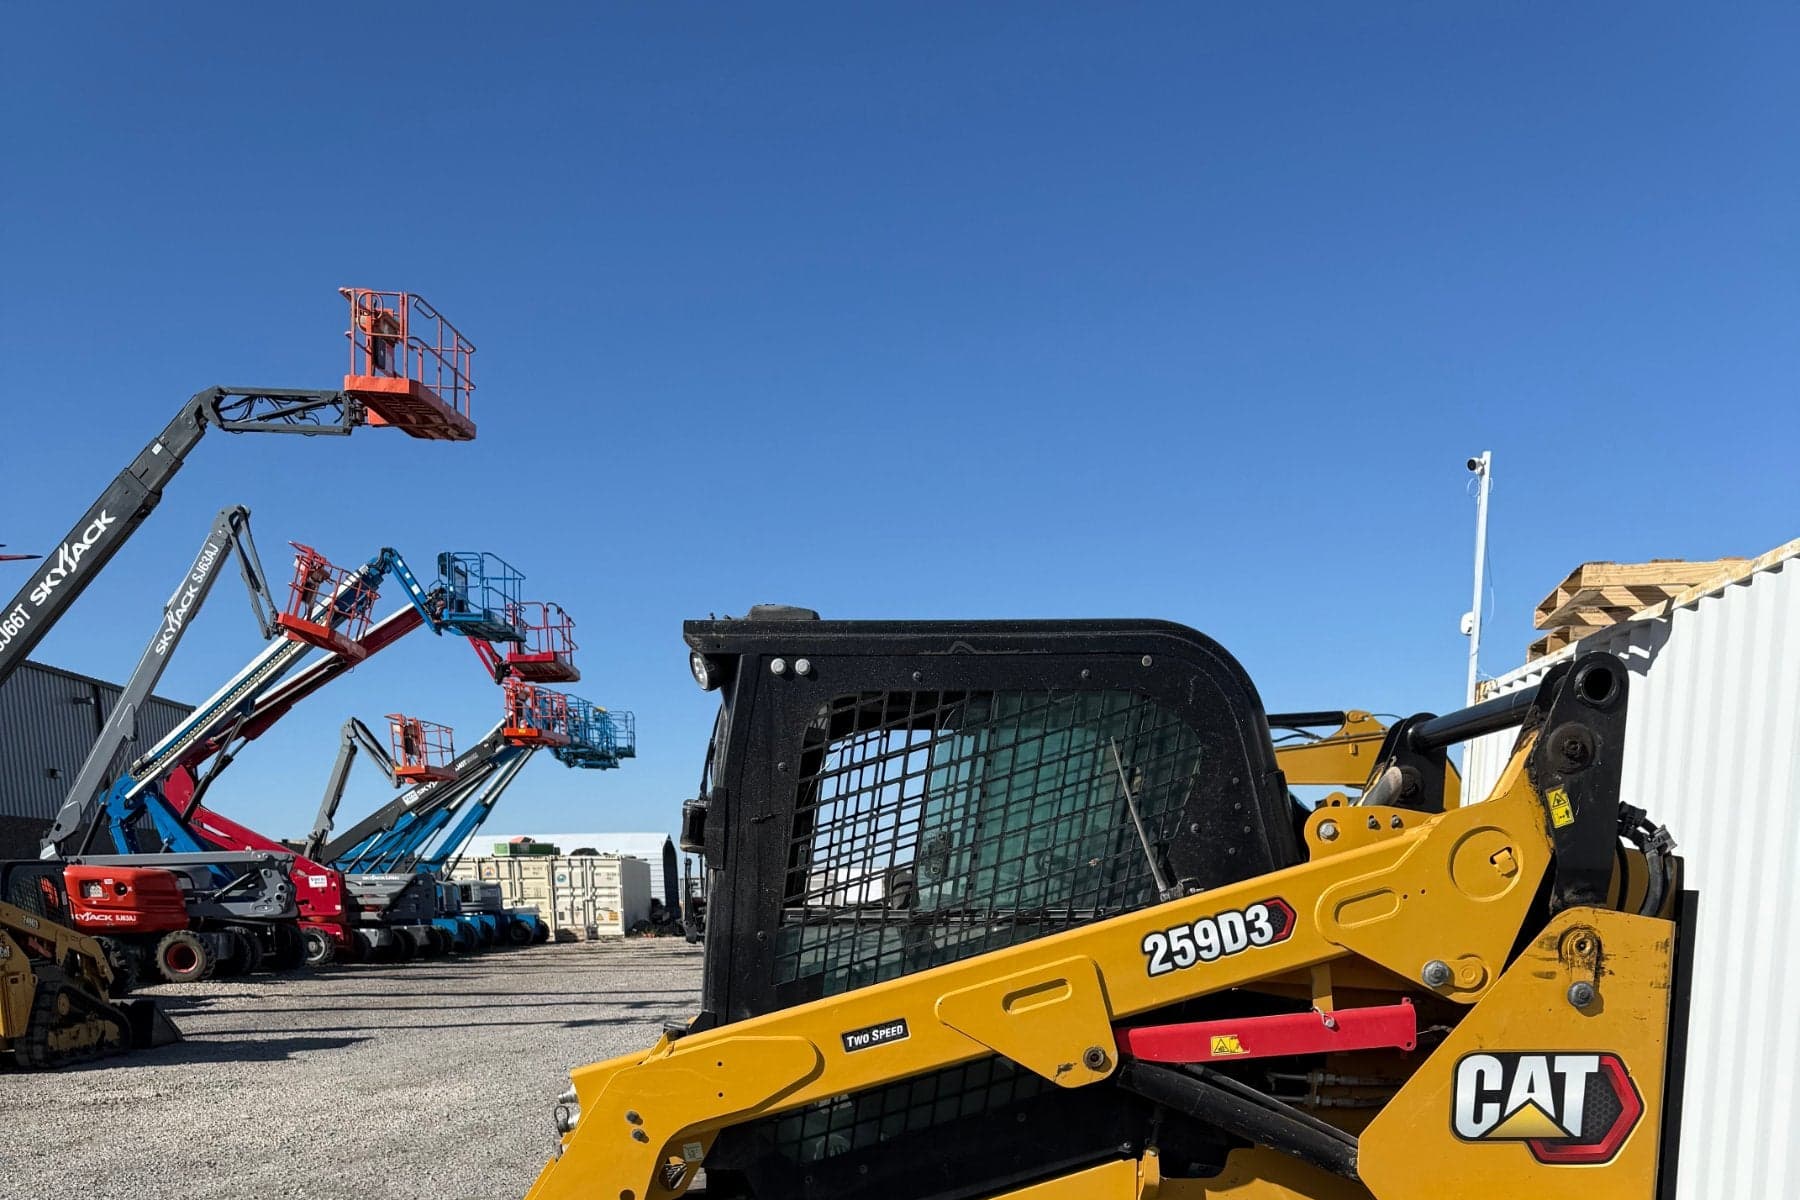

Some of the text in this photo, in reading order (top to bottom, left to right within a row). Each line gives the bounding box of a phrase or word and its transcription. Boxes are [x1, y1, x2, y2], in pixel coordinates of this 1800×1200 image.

[30, 509, 116, 607] SKYJACK
[155, 542, 220, 656] SKYJACK SJ63AJ
[416, 780, 439, 797] SKYJ
[1143, 904, 1274, 976] 259D3
[1455, 1054, 1600, 1139] CAT
